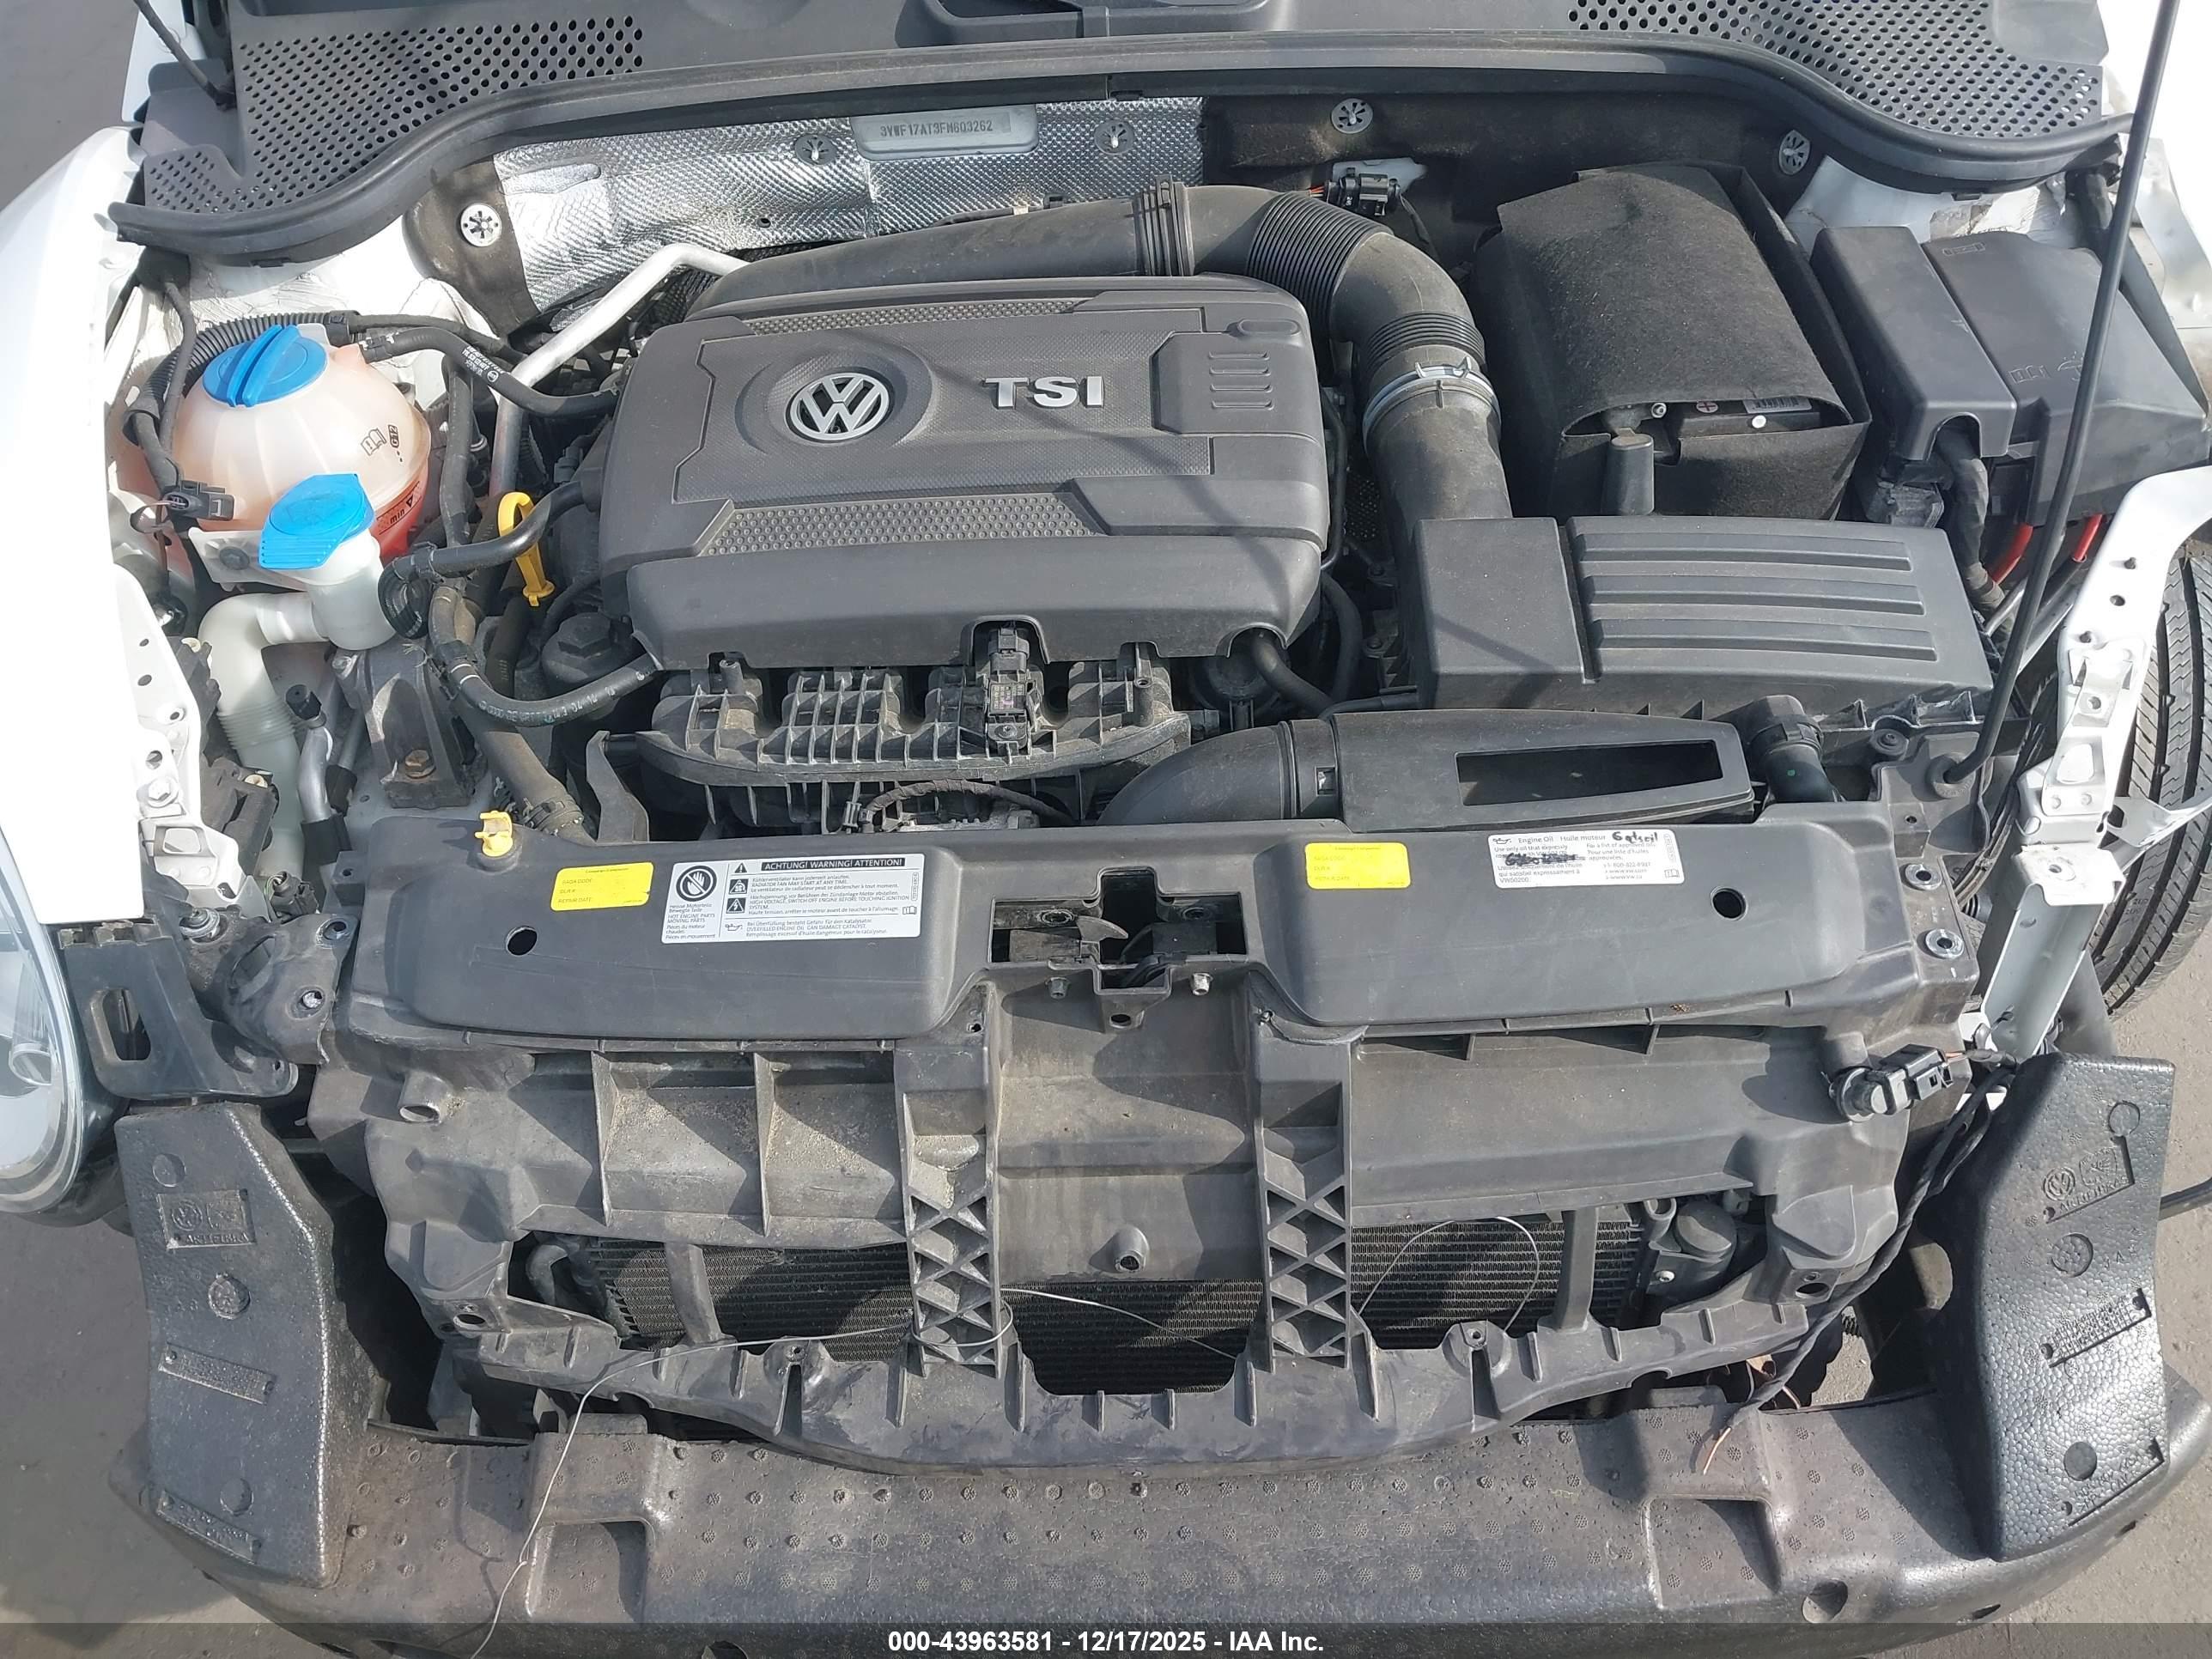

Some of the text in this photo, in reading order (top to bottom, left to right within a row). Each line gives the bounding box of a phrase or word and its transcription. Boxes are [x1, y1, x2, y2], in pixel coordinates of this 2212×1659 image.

[880, 119, 994, 137] 3VWF17AT3FM603262
[985, 375, 1104, 409] TSI
[390, 507, 405, 524] min
[765, 861, 808, 870] ACHTUNG!
[854, 859, 902, 867] ATTENTION!
